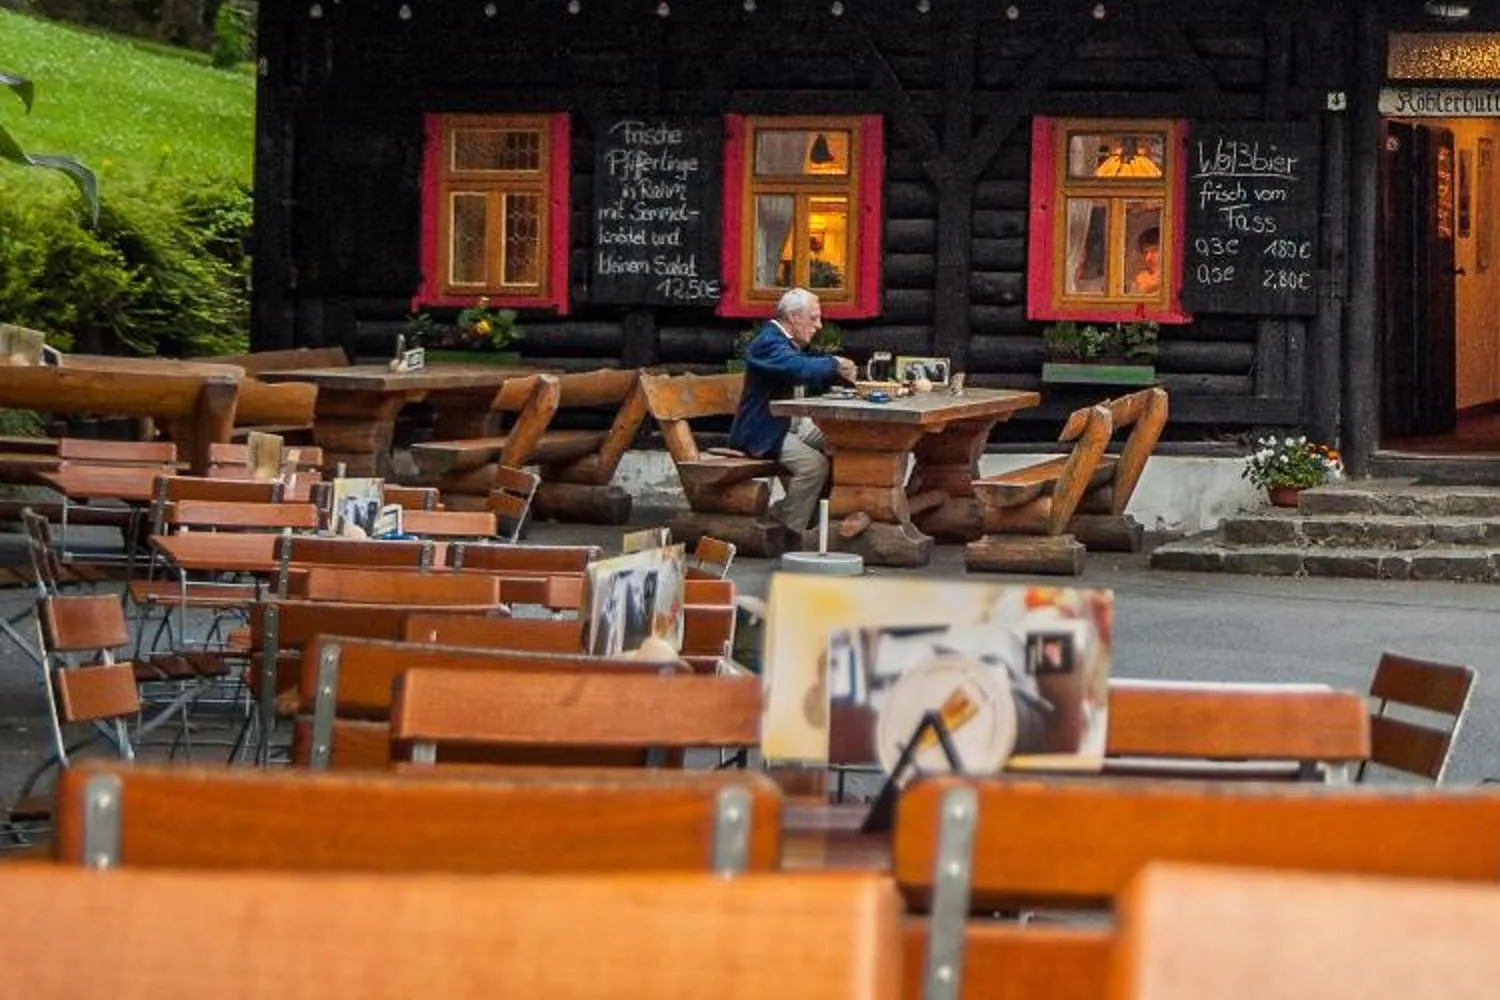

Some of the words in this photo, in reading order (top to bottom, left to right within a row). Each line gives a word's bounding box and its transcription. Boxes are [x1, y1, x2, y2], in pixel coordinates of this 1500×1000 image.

[1199, 180, 1247, 211] frisch
[1253, 189, 1288, 202] vom
[598, 198, 625, 221] mit
[1217, 203, 1278, 234] Fass
[651, 226, 681, 246] und
